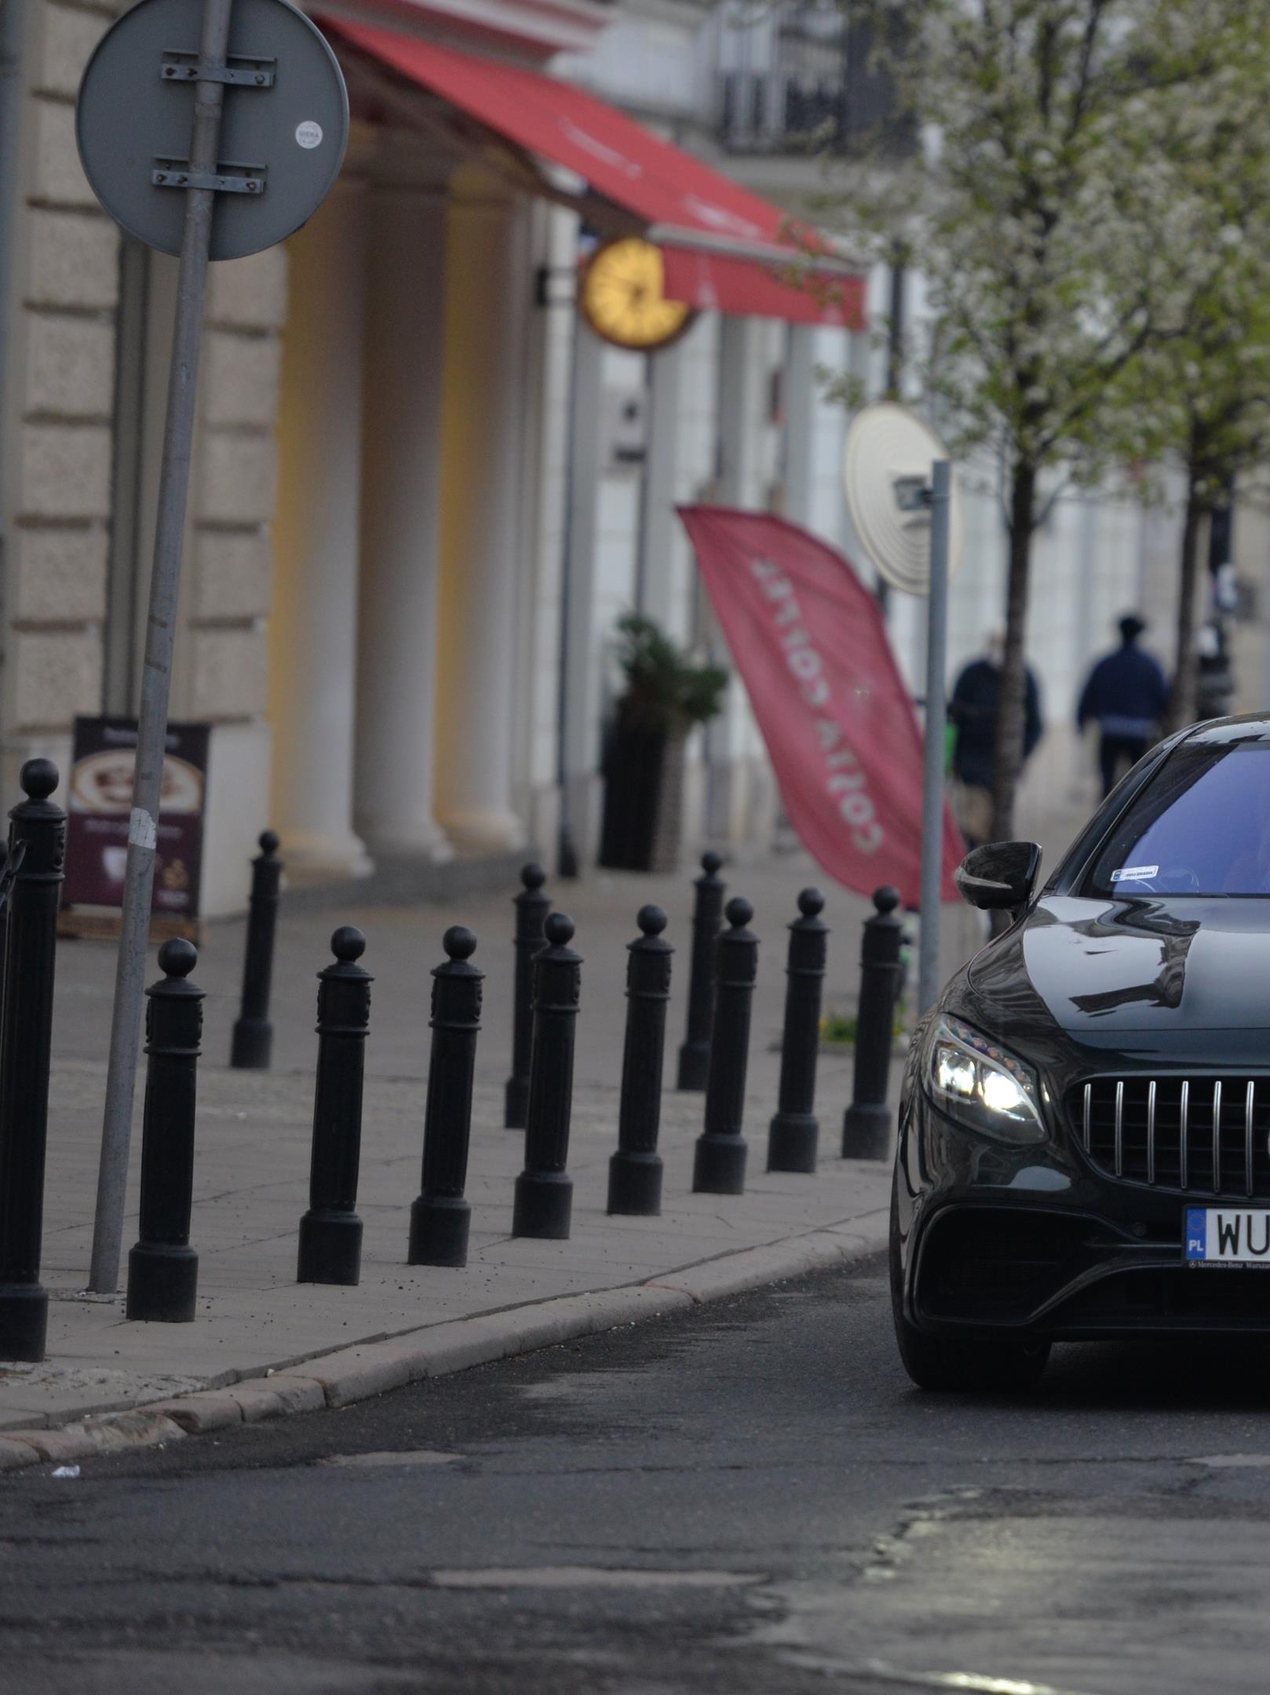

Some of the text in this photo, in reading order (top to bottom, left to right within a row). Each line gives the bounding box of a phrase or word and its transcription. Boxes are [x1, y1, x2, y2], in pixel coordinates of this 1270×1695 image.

[1217, 1214, 1270, 1255] WU
[1188, 1239, 1204, 1252] PL
[1197, 1261, 1243, 1269] Mercedes-Benz
